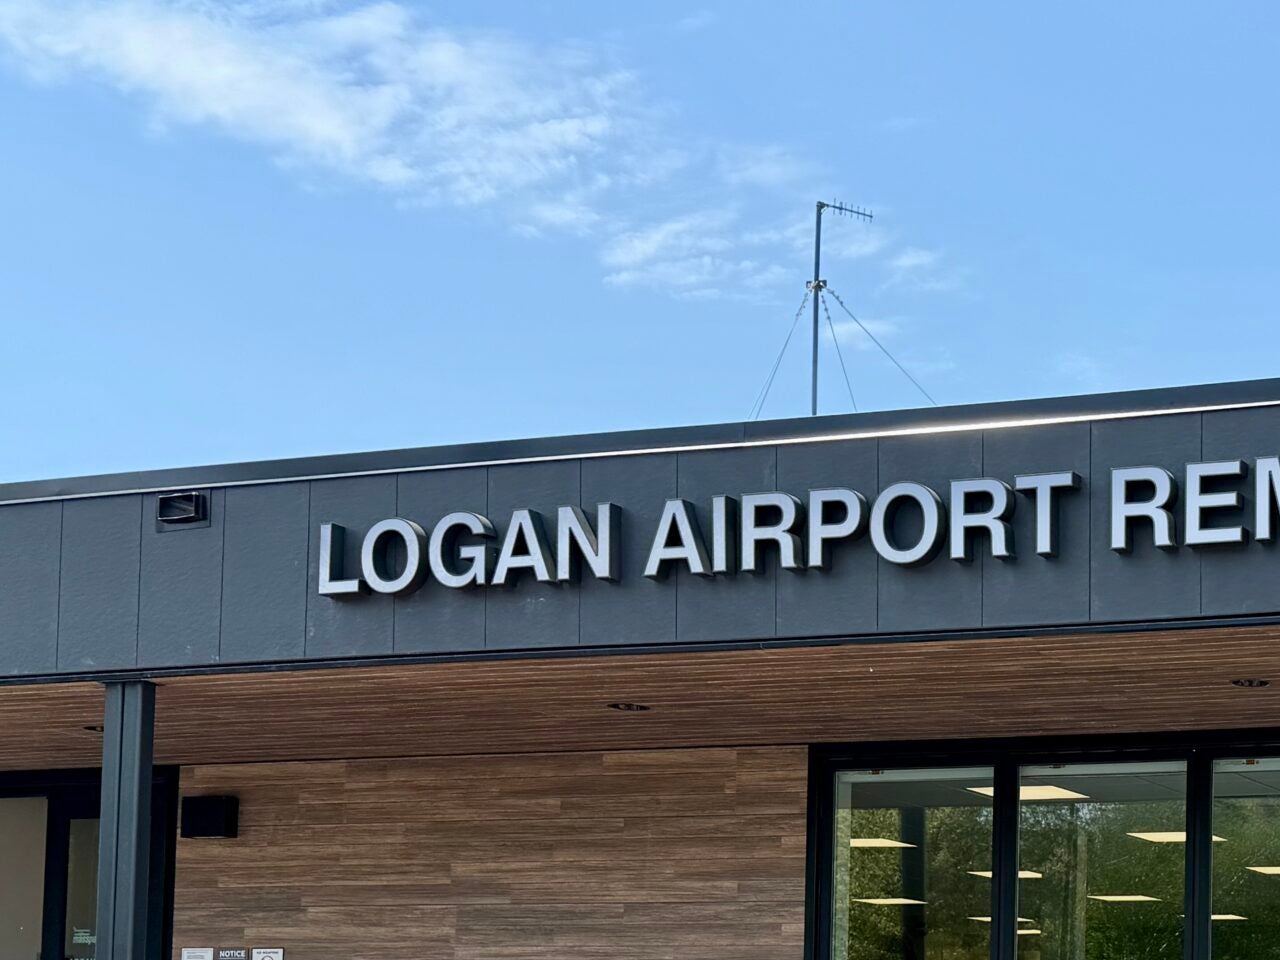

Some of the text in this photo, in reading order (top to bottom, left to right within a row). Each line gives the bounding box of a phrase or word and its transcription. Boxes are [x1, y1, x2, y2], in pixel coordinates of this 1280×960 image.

[318, 501, 622, 598] LOGAN
[643, 470, 1082, 581] AIRPORT
[219, 950, 246, 958] NOTICE
